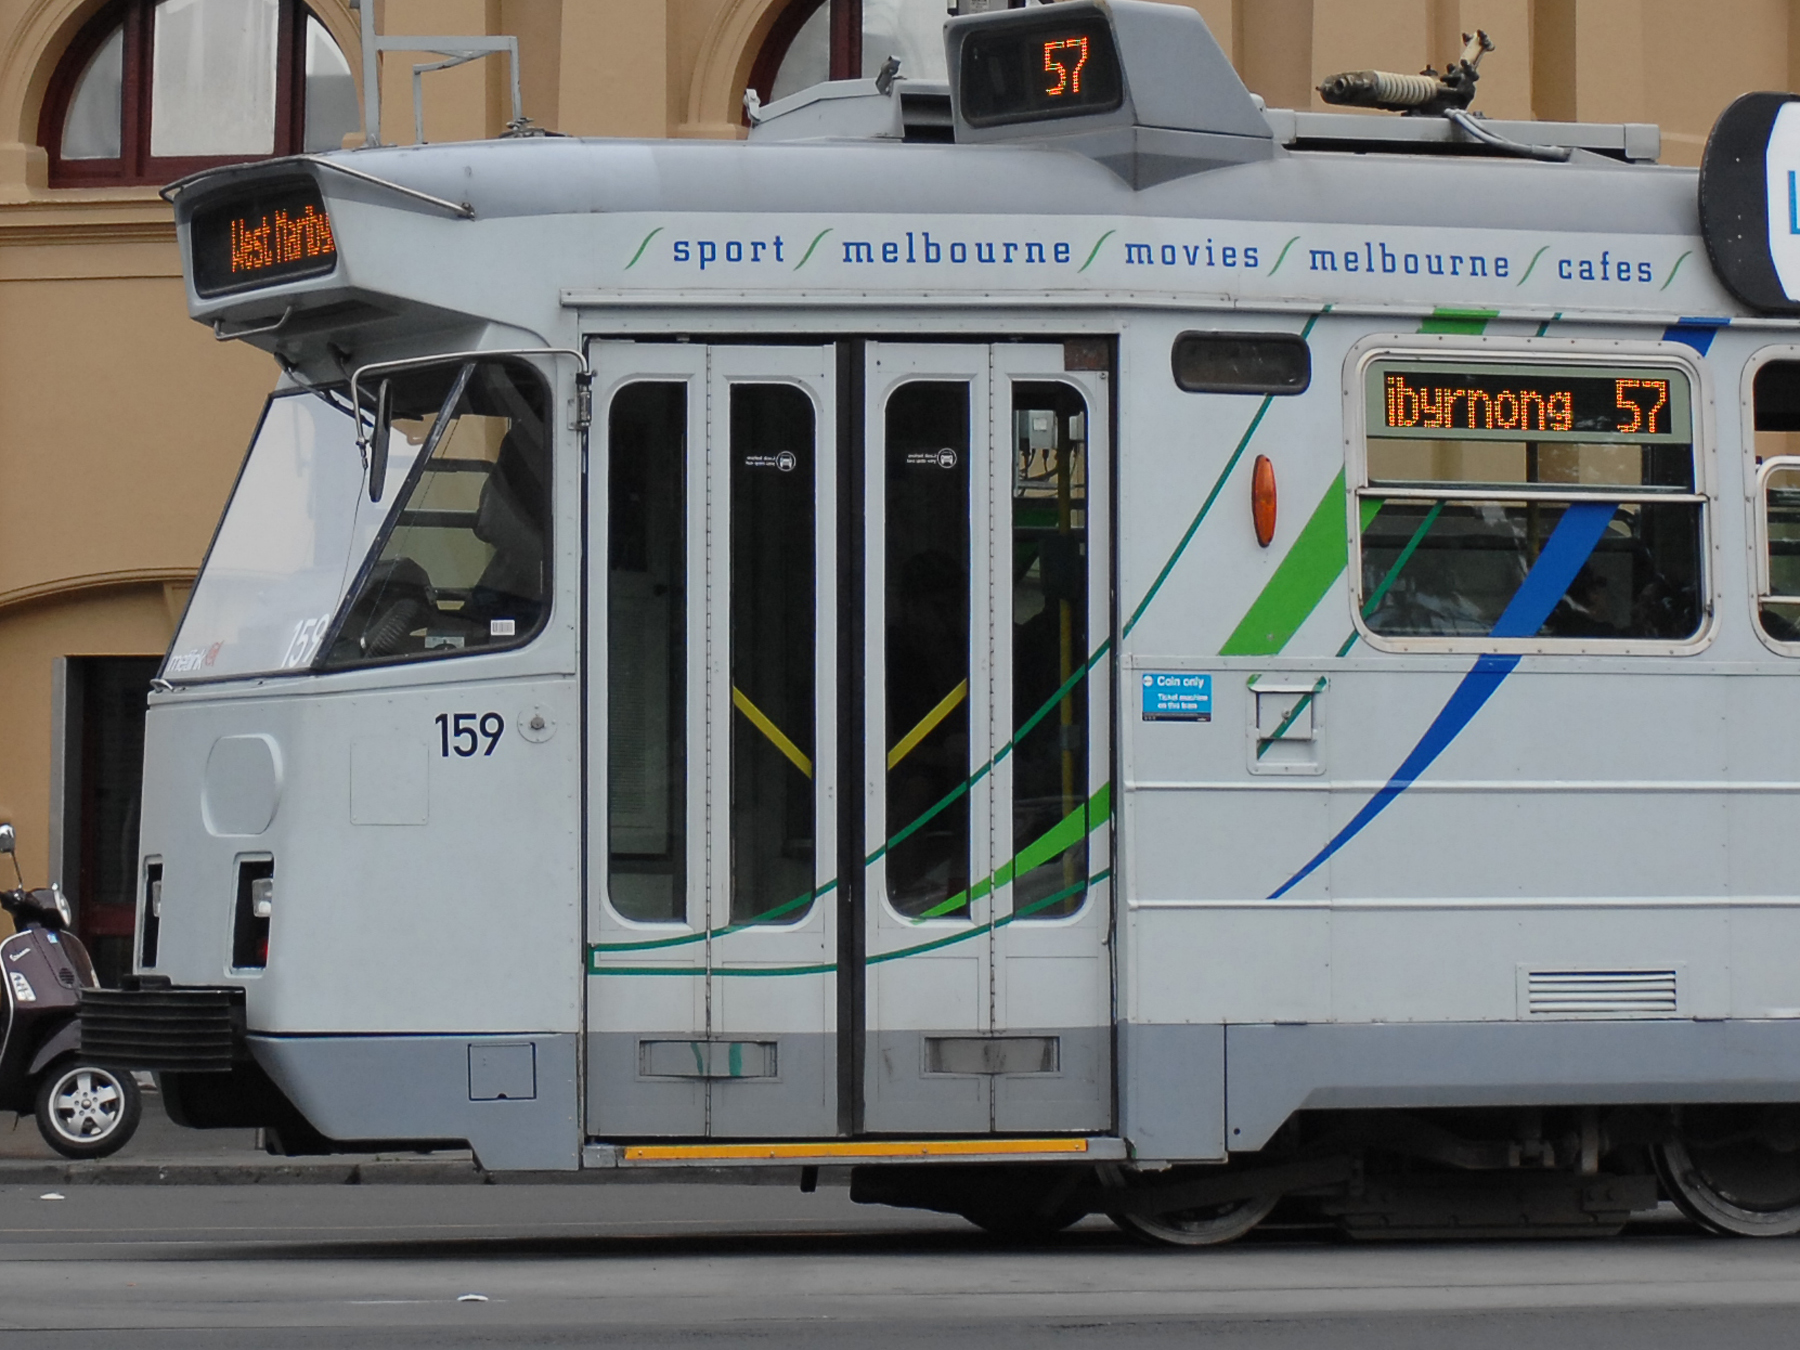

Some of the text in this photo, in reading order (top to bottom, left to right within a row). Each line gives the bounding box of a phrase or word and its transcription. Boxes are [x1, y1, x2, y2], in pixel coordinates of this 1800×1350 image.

[1044, 36, 1089, 96] 57
[231, 216, 273, 273] West
[673, 232, 1653, 282] sport melbourne movies melbourne cafes
[1615, 379, 1667, 433] 57
[280, 613, 330, 668] 159
[435, 712, 505, 757] 159
